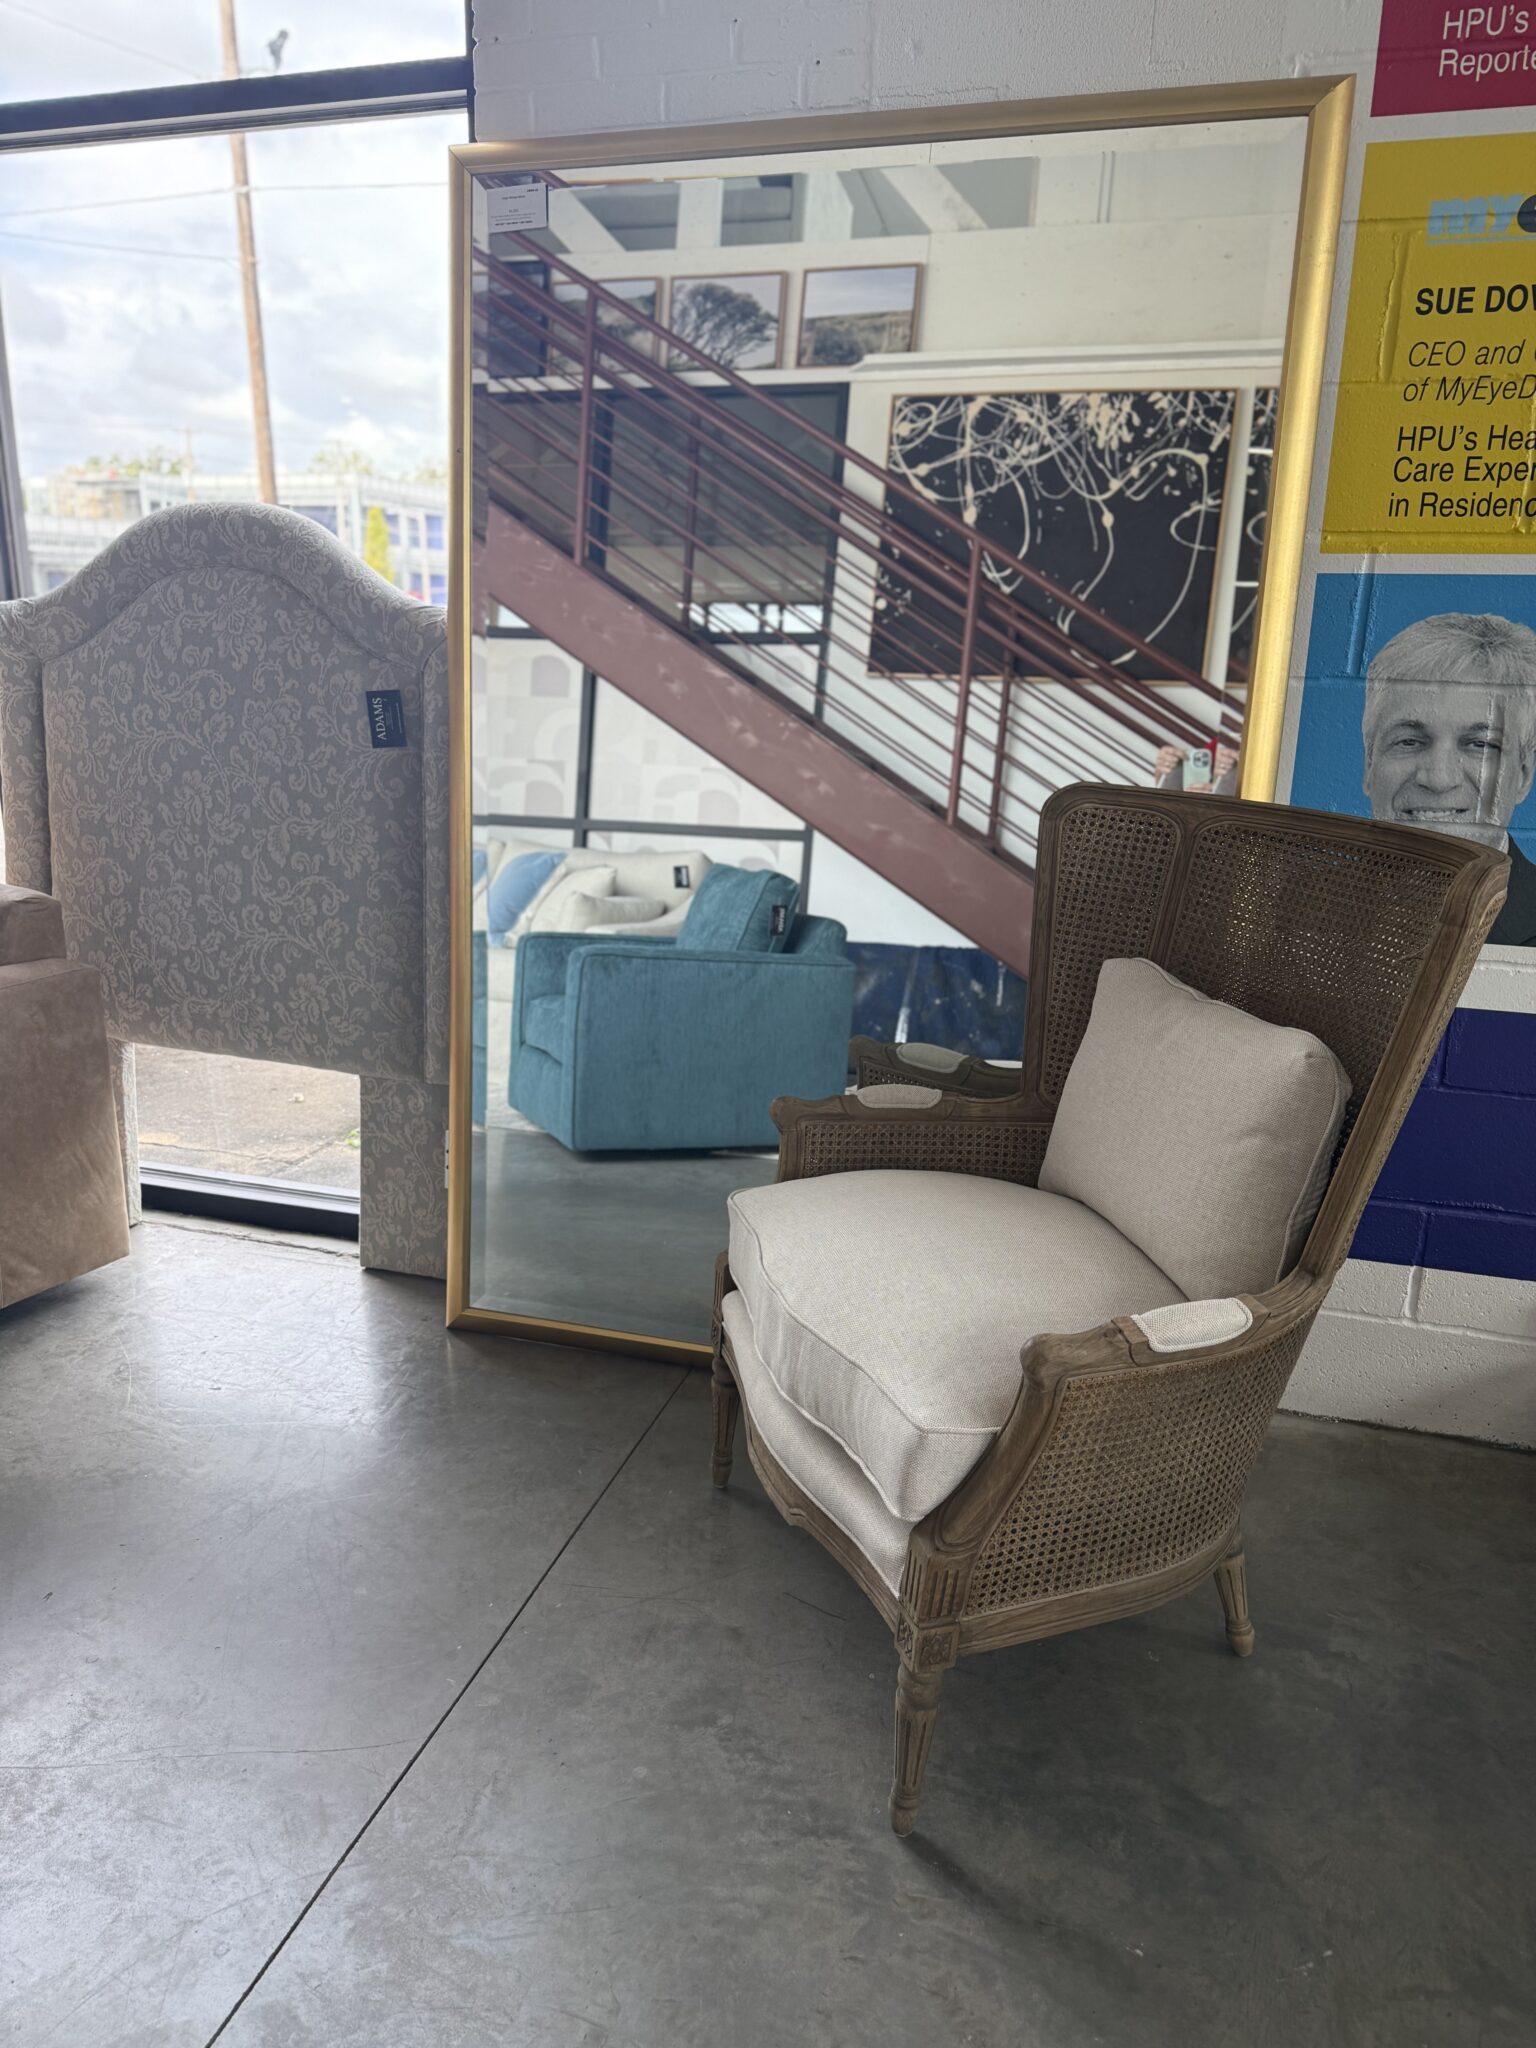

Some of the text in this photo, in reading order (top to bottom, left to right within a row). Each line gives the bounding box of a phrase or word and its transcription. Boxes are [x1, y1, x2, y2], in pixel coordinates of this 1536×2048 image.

[1442, 4, 1530, 40] HPU's
[1415, 284, 1536, 316] SUE DO
[1408, 340, 1467, 368] CEO
[1474, 339, 1526, 366] and
[1402, 374, 1536, 406] of MyEyeD
[1397, 424, 1536, 452] HPU's Hea
[1393, 456, 1454, 483] Care
[1388, 491, 1536, 518] in Residenc
[372, 697, 387, 741] ADAMS
